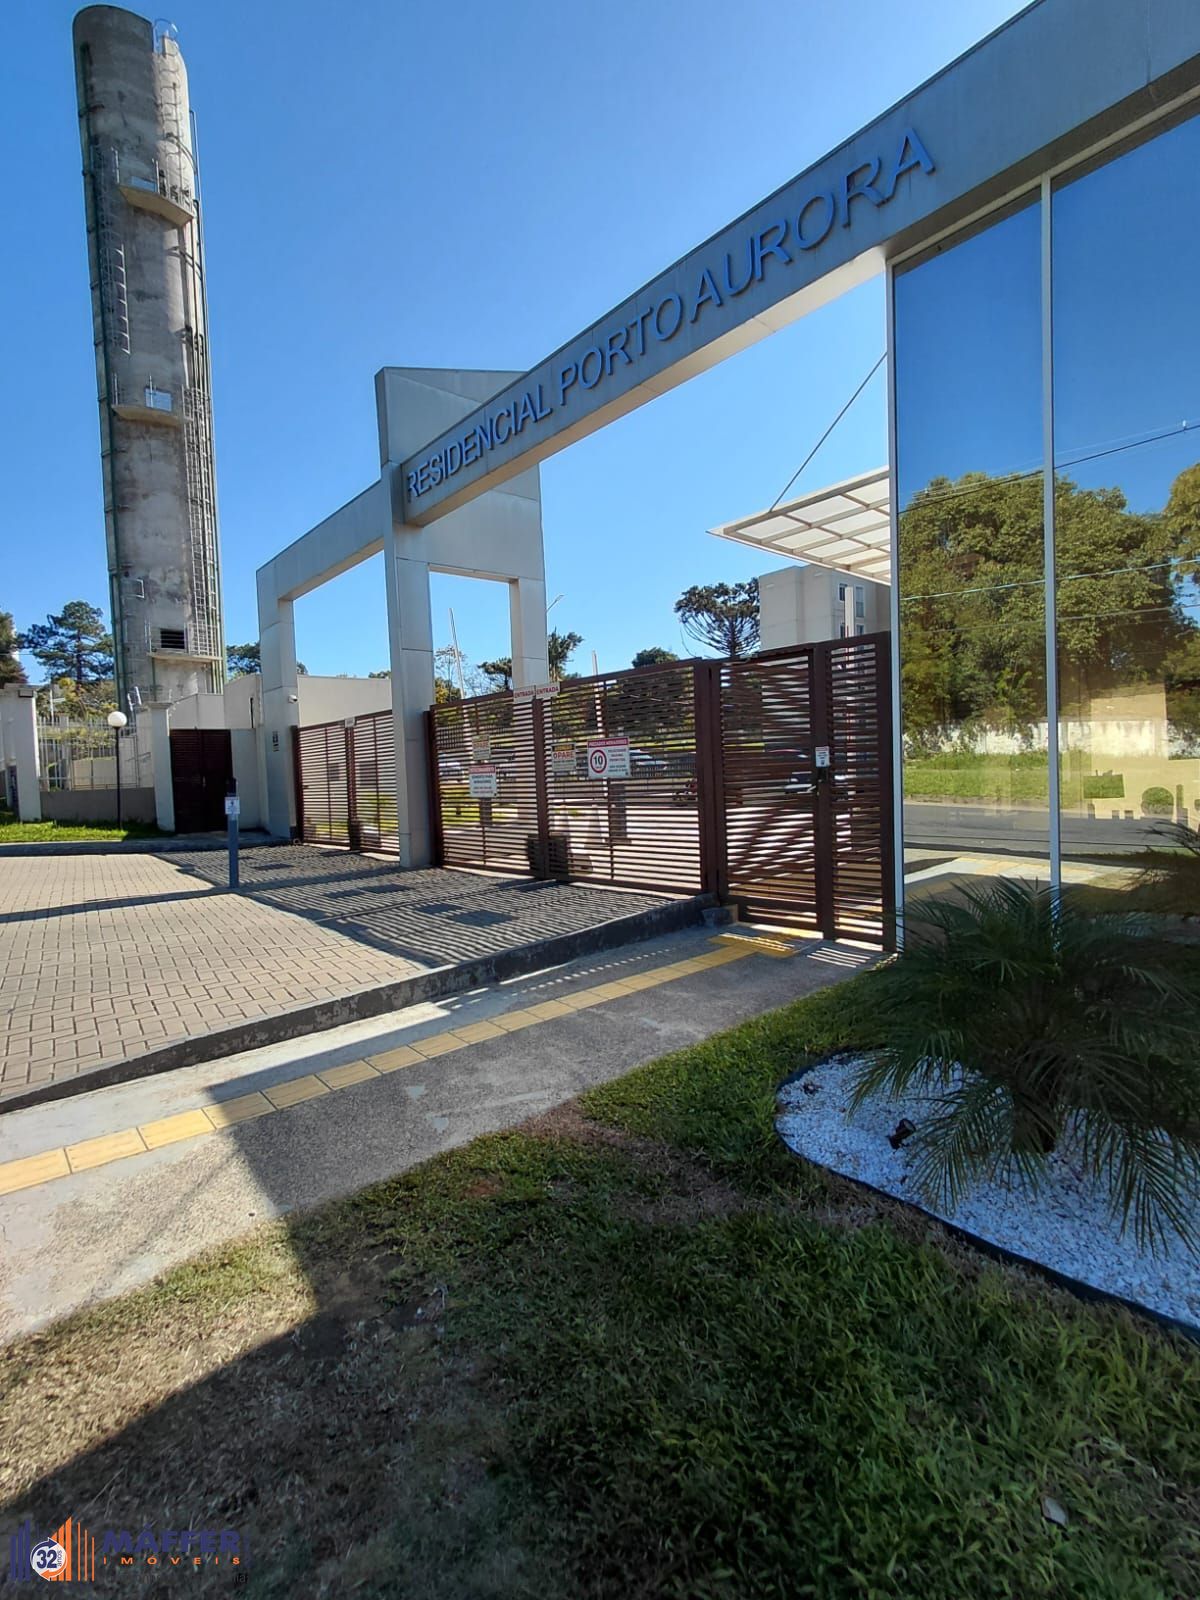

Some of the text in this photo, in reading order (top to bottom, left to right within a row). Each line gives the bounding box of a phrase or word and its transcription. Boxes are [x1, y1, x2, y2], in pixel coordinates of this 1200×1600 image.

[407, 127, 936, 503] RESIDENCIAL PORTO AURORA
[537, 686, 559, 695] ENTRADA
[593, 755, 603, 765] 10
